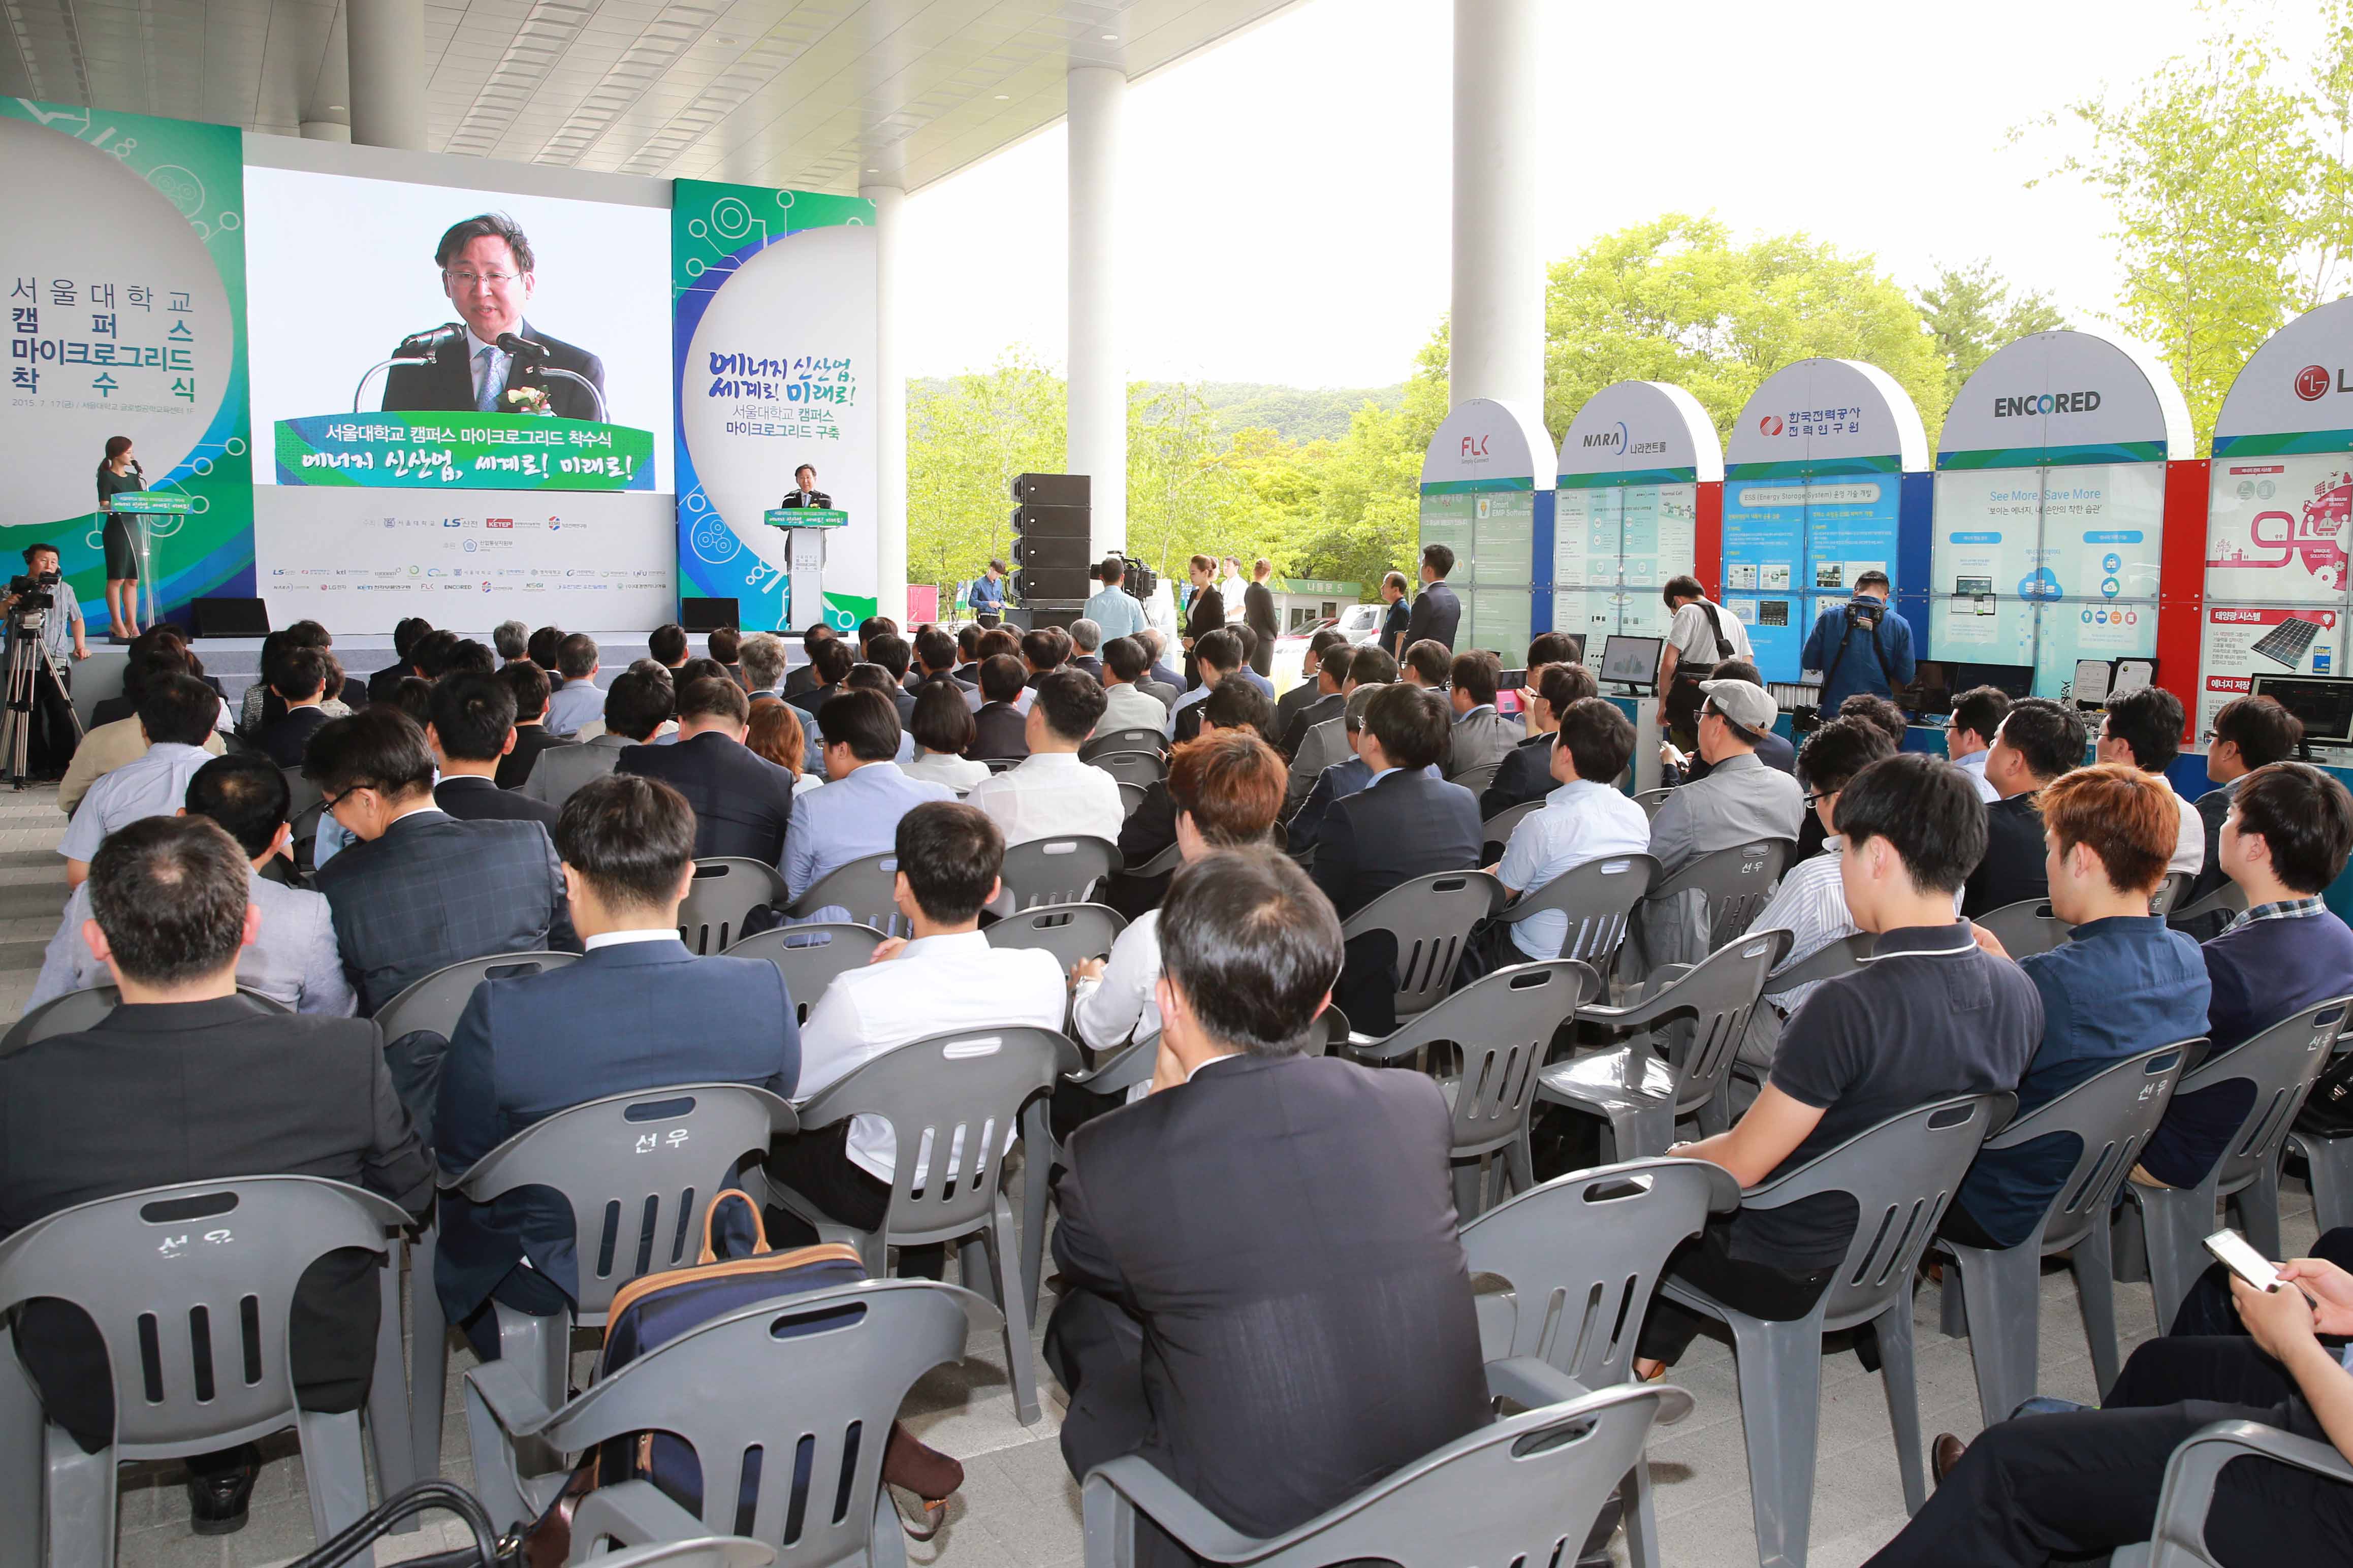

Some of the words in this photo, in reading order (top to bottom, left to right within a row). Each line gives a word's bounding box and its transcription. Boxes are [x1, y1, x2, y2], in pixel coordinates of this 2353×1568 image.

[11, 277, 194, 313] 서울대학교
[12, 307, 194, 342] 캠퍼스
[12, 337, 194, 372] 마이크로그리드
[709, 352, 787, 379] 에너지
[793, 357, 855, 382] 신산업,
[11, 367, 195, 403] 착수식
[709, 377, 779, 401] 세계로!
[787, 381, 856, 406] 미래로!
[733, 404, 794, 421] 서울대학교
[799, 408, 834, 423] 캠퍼스
[1995, 391, 2101, 417] ENCORED
[1789, 407, 1861, 423] 한국전력공사
[326, 424, 406, 442] 서울대학교
[410, 426, 457, 443] 캠퍼스
[461, 428, 565, 446] 마이크로그리드
[568, 430, 612, 448] 착수식
[726, 421, 812, 438] 마이크로그리드
[816, 425, 840, 440] 구축
[1789, 422, 1859, 437] 전력연구원
[1583, 433, 1619, 447] NARA
[1630, 442, 1666, 454] 나라컨트롤
[302, 452, 374, 469] 에너지
[386, 449, 463, 482] 신산업,
[475, 453, 549, 479] 세계로!
[560, 455, 633, 481] 미래로!
[1757, 493, 1779, 502] (Energy
[1807, 491, 1832, 499] System)
[1847, 490, 1858, 498] 기술
[1860, 489, 1872, 497] 개발
[1990, 492, 2008, 501] See
[2012, 491, 2040, 501] More,
[2044, 490, 2069, 500] Save
[2073, 489, 2101, 499] More
[1506, 508, 1531, 517] Software
[2046, 505, 2066, 515] 손안의
[2069, 505, 2083, 515] 착한
[443, 519, 461, 527] LS
[1337, 584, 1343, 593] 5
[2215, 611, 2237, 621] 태양광
[2239, 612, 2261, 621] 시스템
[2211, 679, 2233, 689] 에너지
[2235, 681, 2250, 690] 저장
[1742, 861, 1763, 874] 선우
[2152, 898, 2163, 909] 우
[2307, 1032, 2333, 1051] 선우
[2138, 1079, 2168, 1101] 선우
[635, 1128, 689, 1154] 선우
